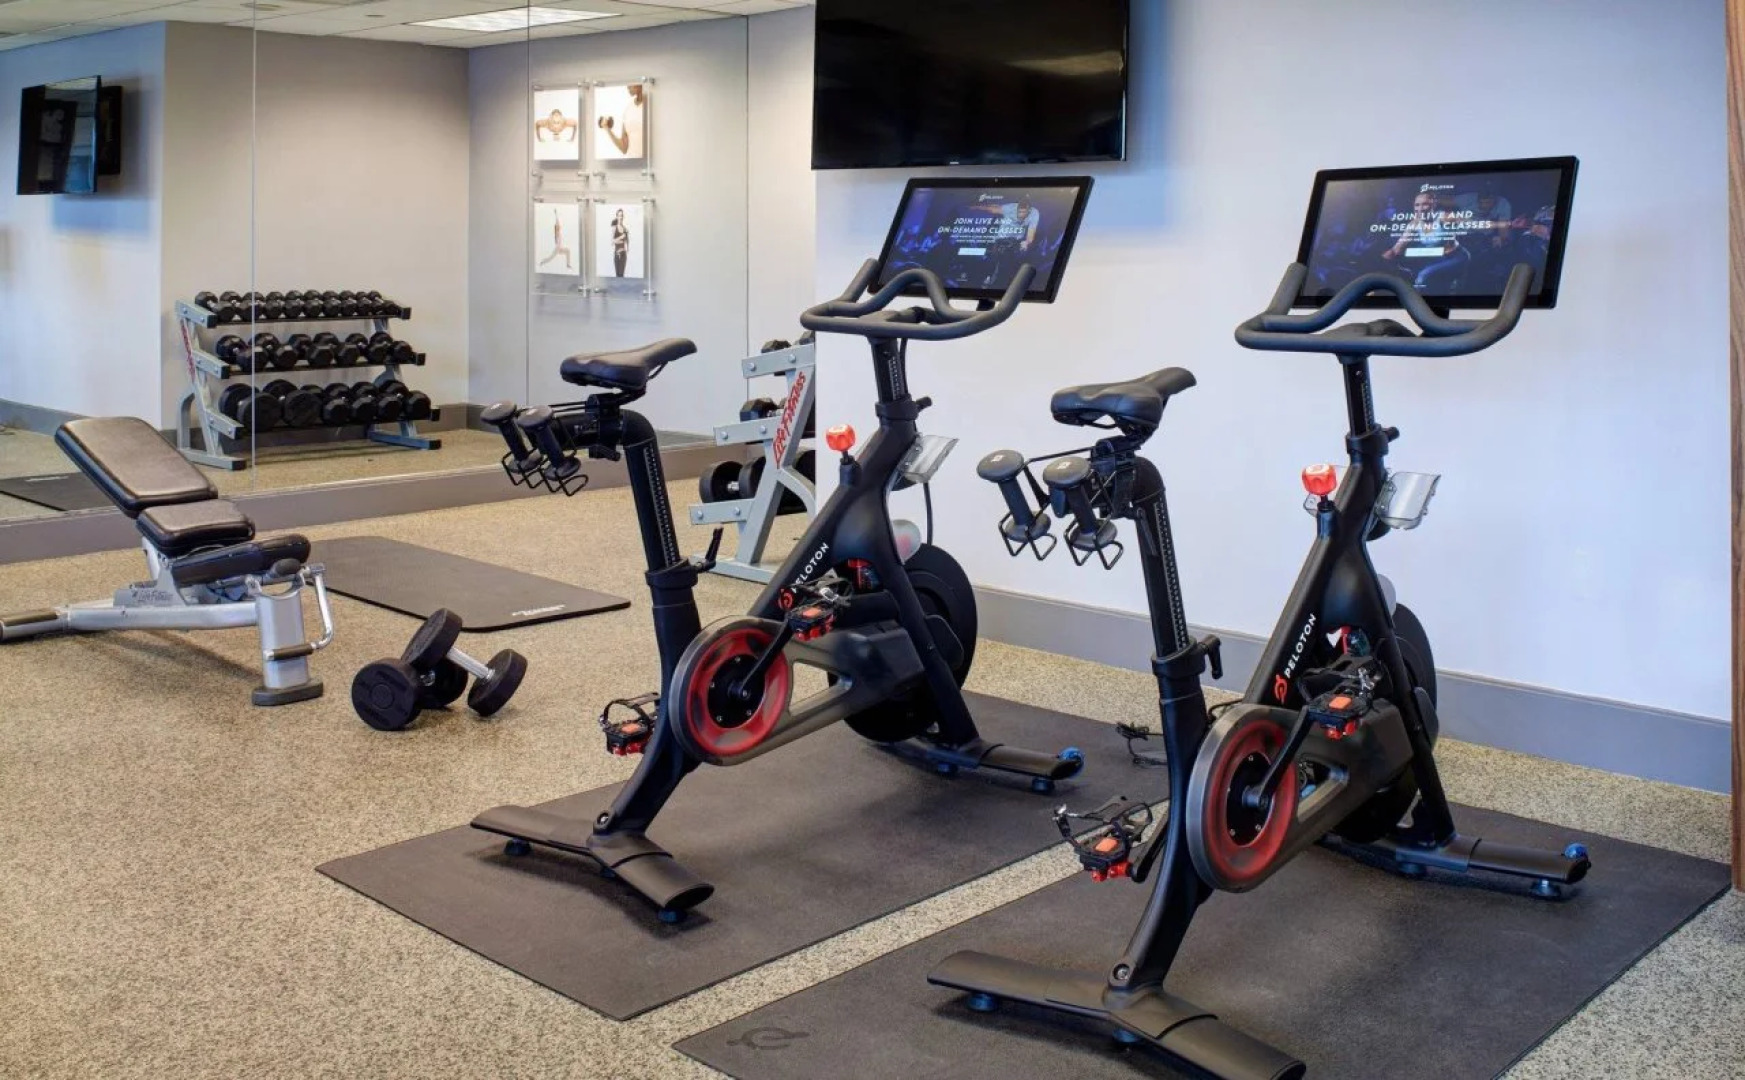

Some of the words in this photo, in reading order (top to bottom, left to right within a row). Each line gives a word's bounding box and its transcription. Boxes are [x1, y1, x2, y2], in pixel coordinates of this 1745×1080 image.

[953, 217, 973, 225] JOIN
[975, 217, 992, 225] LIVE
[994, 217, 1013, 225] AND
[1390, 212, 1417, 222] JOIN
[1420, 211, 1444, 220] LIVE
[1447, 210, 1473, 219] AND
[937, 226, 988, 234] ON-DEMAND
[989, 226, 1023, 234] CLASSES
[1369, 221, 1442, 233] ON-DEMAND
[1443, 220, 1492, 230] CLASSES
[1283, 612, 1317, 679] PELOTON
